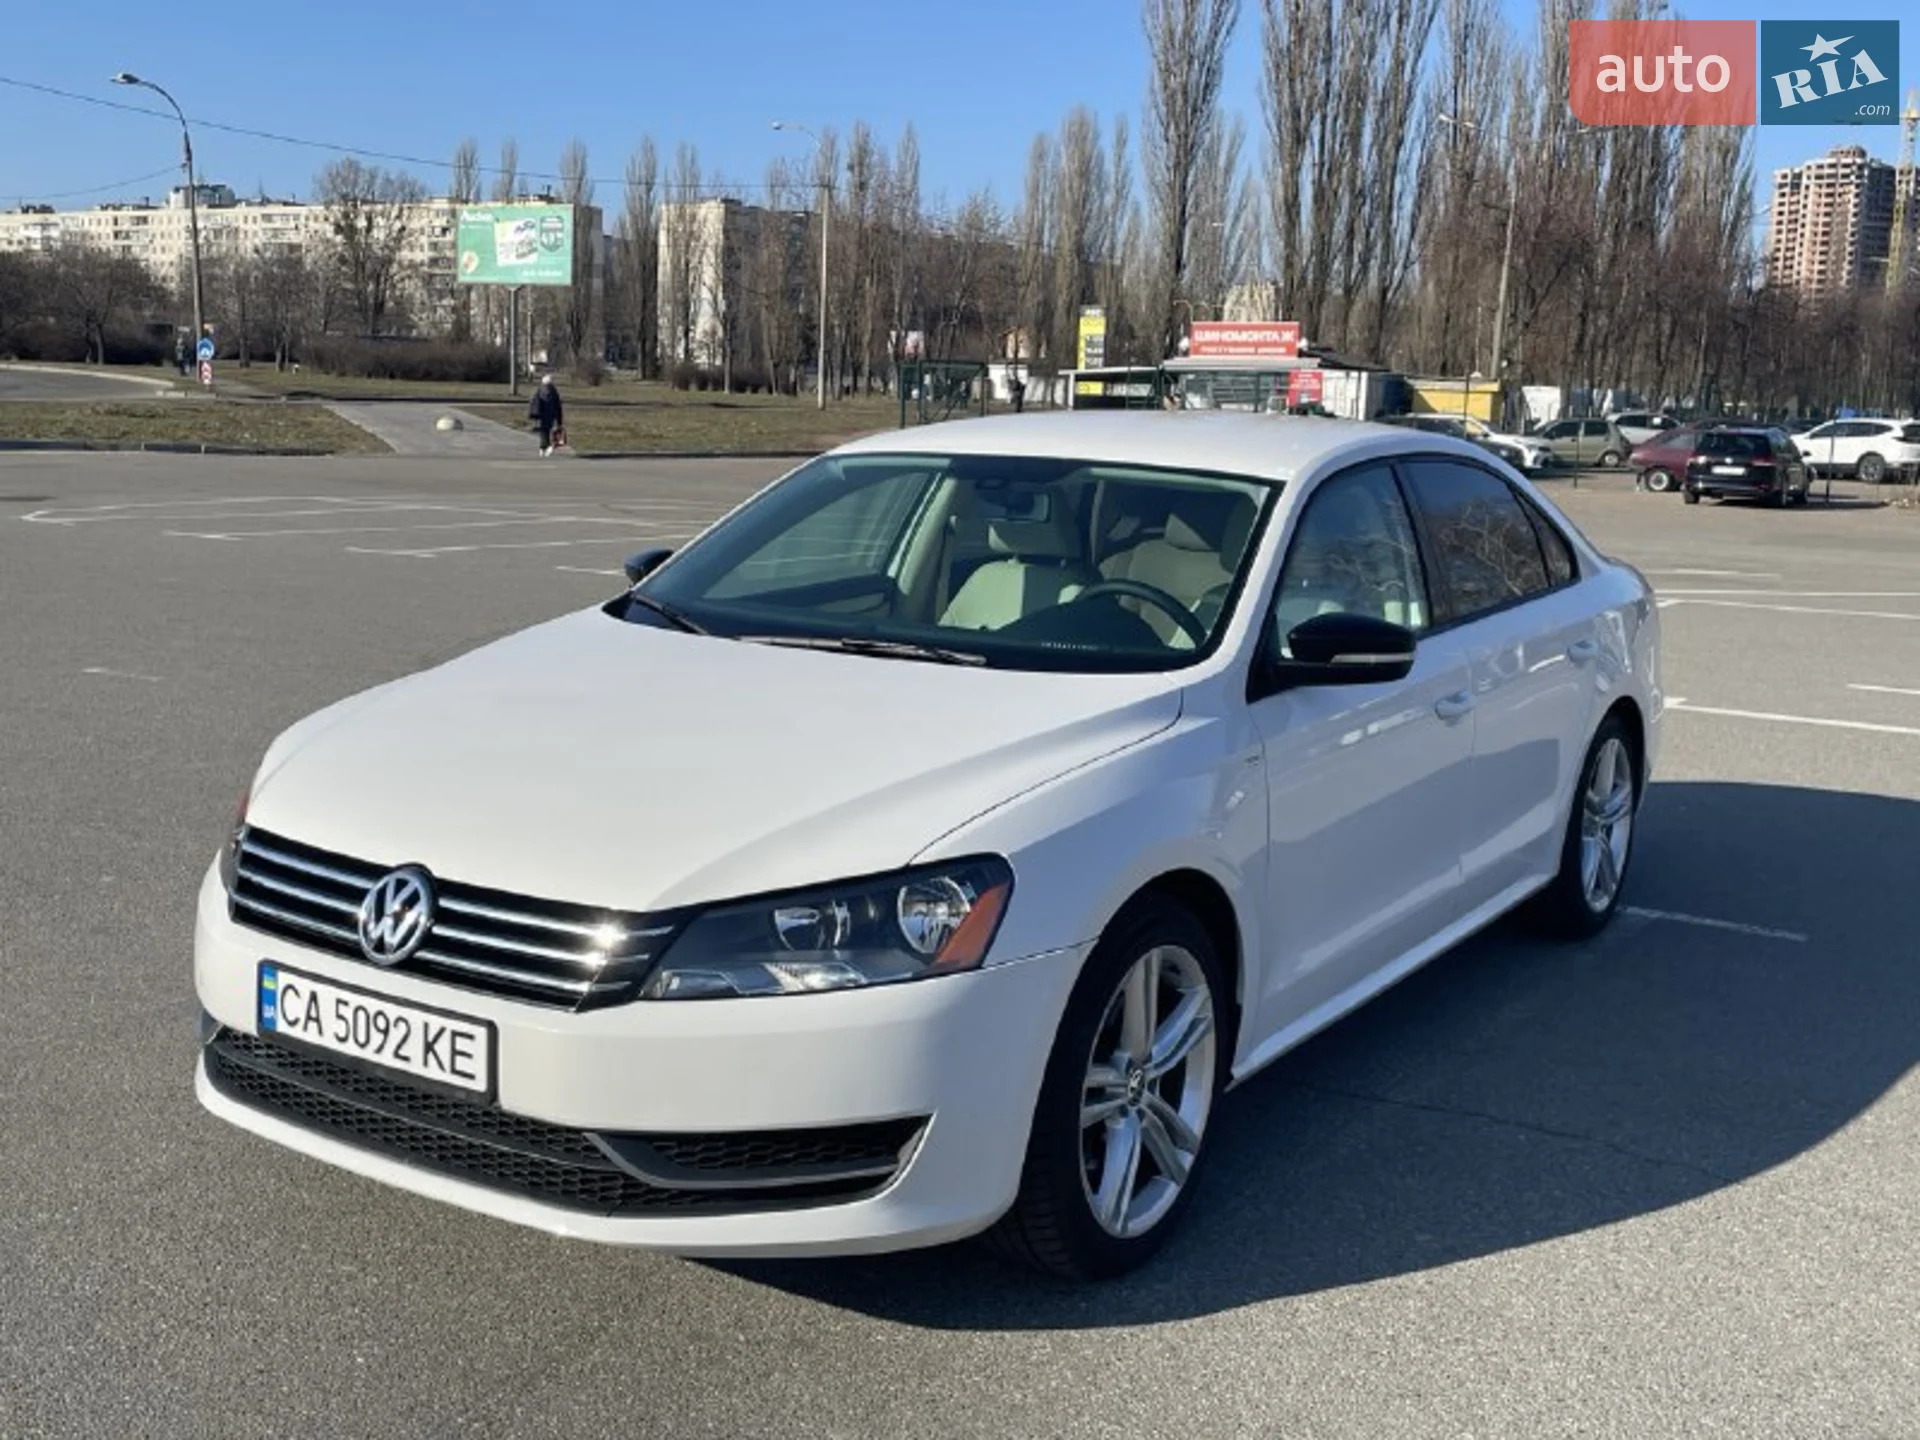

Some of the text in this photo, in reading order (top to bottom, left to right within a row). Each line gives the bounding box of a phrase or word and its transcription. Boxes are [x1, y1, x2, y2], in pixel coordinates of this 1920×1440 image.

[279, 984, 477, 1081] CA 5092 KE
